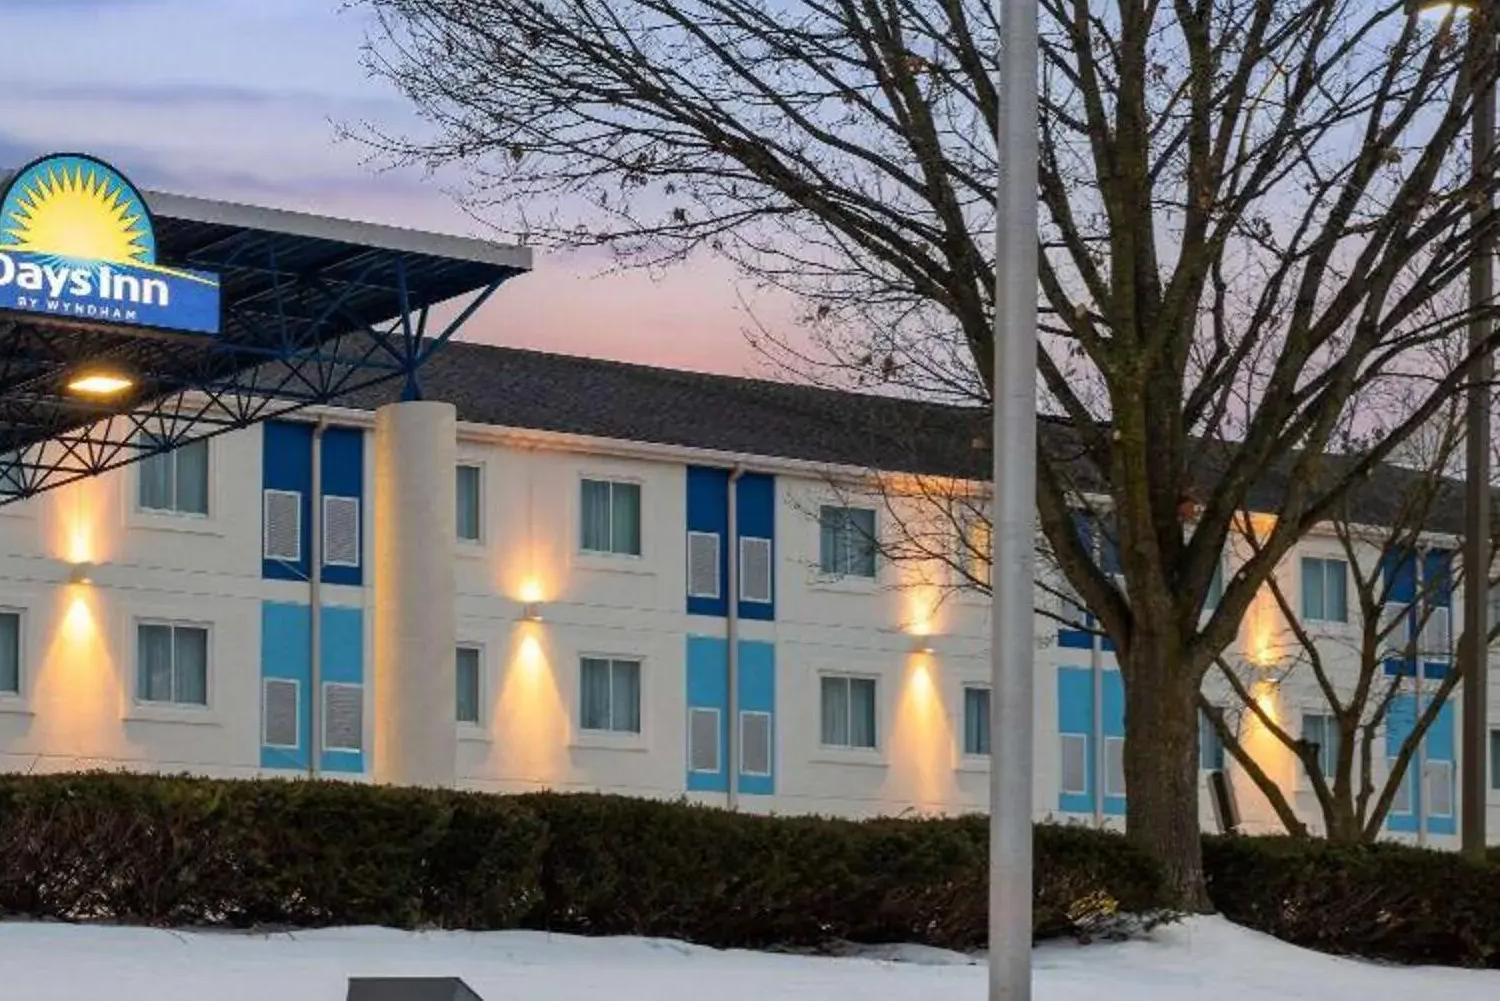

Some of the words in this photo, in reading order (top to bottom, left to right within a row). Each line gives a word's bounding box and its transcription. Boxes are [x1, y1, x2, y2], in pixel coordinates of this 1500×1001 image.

[101, 266, 168, 306] Inn
[17, 296, 37, 308] BY
[47, 301, 137, 320] WYNDHAM
